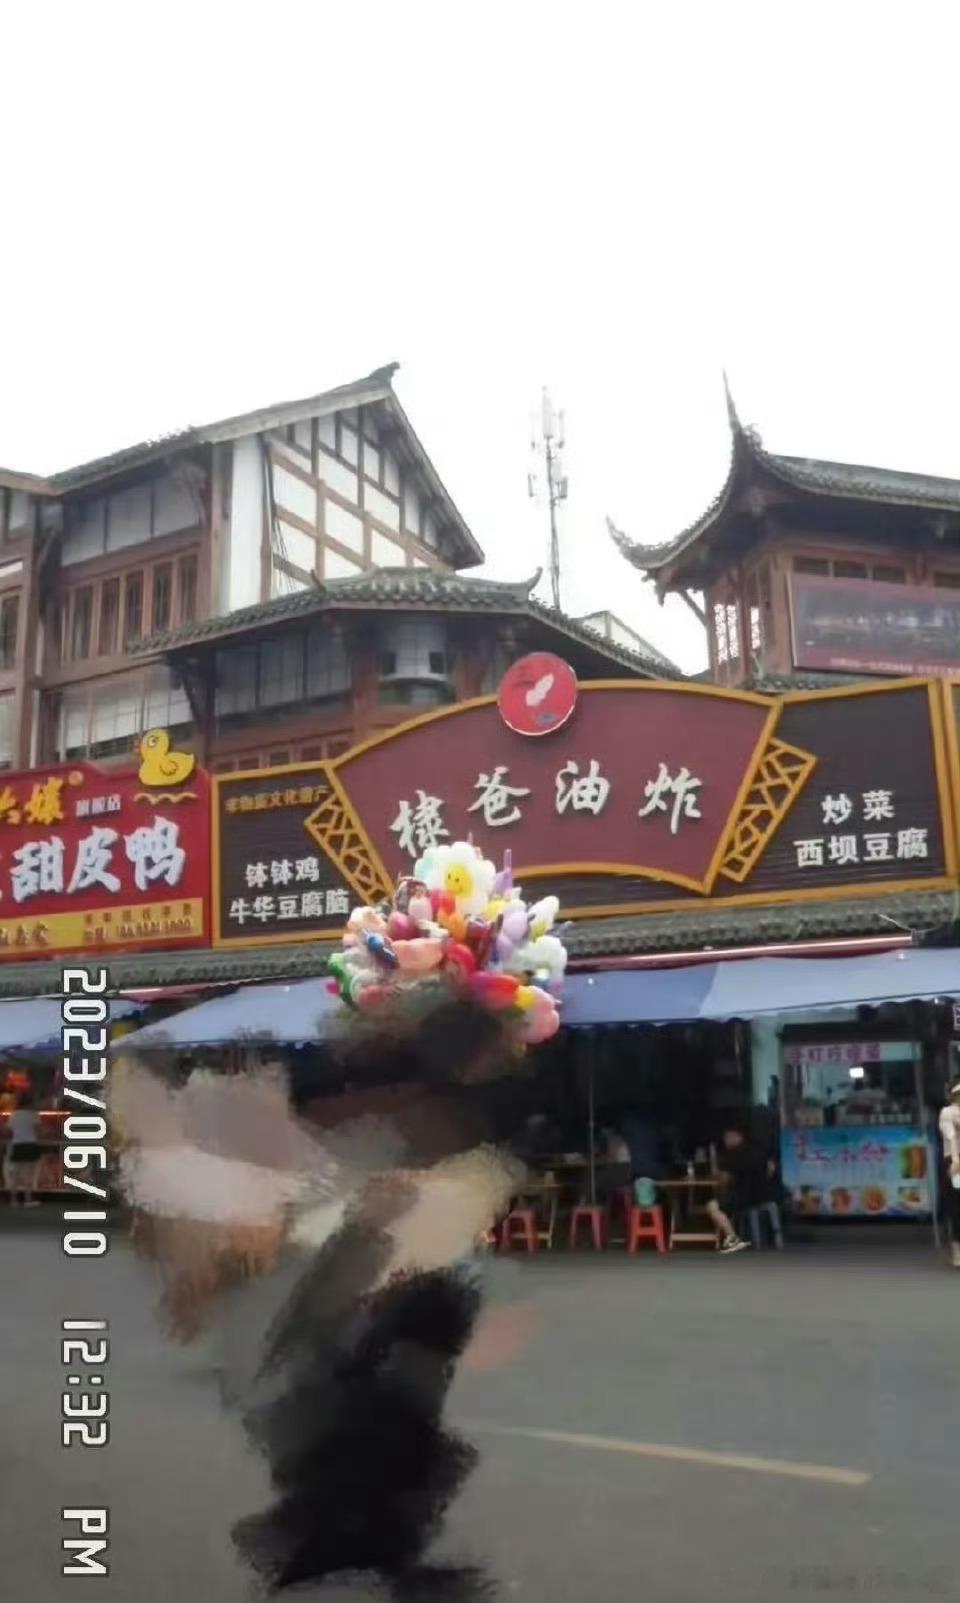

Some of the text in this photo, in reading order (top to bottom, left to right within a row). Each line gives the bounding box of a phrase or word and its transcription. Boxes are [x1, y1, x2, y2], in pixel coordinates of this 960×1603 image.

[821, 789, 895, 825] 炒菜
[793, 827, 929, 868] 西坝豆腐
[245, 856, 320, 888] 钵钵鸡
[229, 889, 350, 925] 牛华豆腐脑
